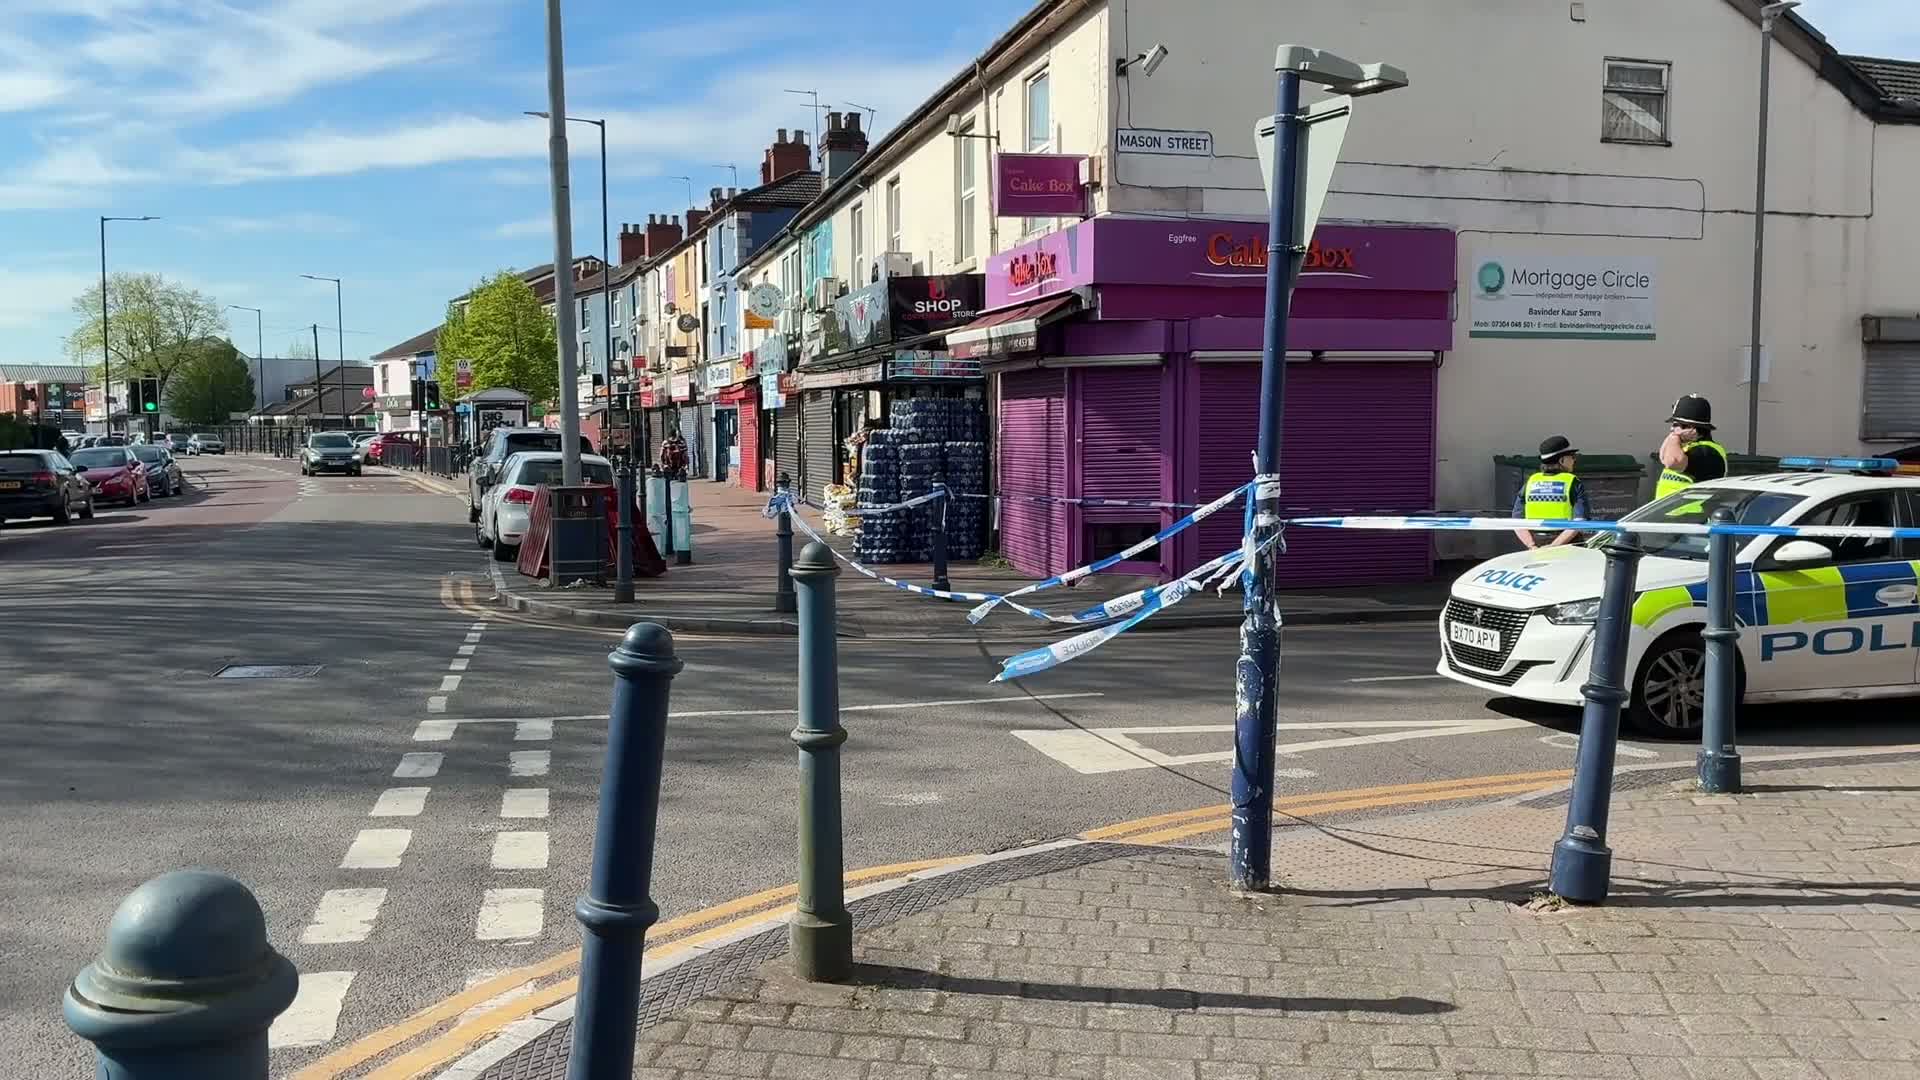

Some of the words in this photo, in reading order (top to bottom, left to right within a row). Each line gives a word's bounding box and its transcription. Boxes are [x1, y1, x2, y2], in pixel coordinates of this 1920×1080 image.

[1119, 134, 1161, 149] MASON
[1167, 136, 1209, 151] STREET
[1009, 177, 1043, 192] Cake
[1048, 179, 1074, 193] Box
[1168, 233, 1197, 244] Eggfree
[1207, 232, 1269, 268] Cak
[1511, 268, 1597, 290] Mortgage
[1602, 269, 1649, 289] Circle
[914, 299, 961, 313] SHOP
[1528, 307, 1560, 317] Bavinder
[1561, 308, 1578, 317] Kaur
[1578, 308, 1601, 318] Samra
[952, 310, 975, 319] STORE
[481, 411, 503, 421] BIG
[1472, 569, 1546, 591] POLICE
[1454, 624, 1475, 643] BX70
[1477, 630, 1495, 648] APY
